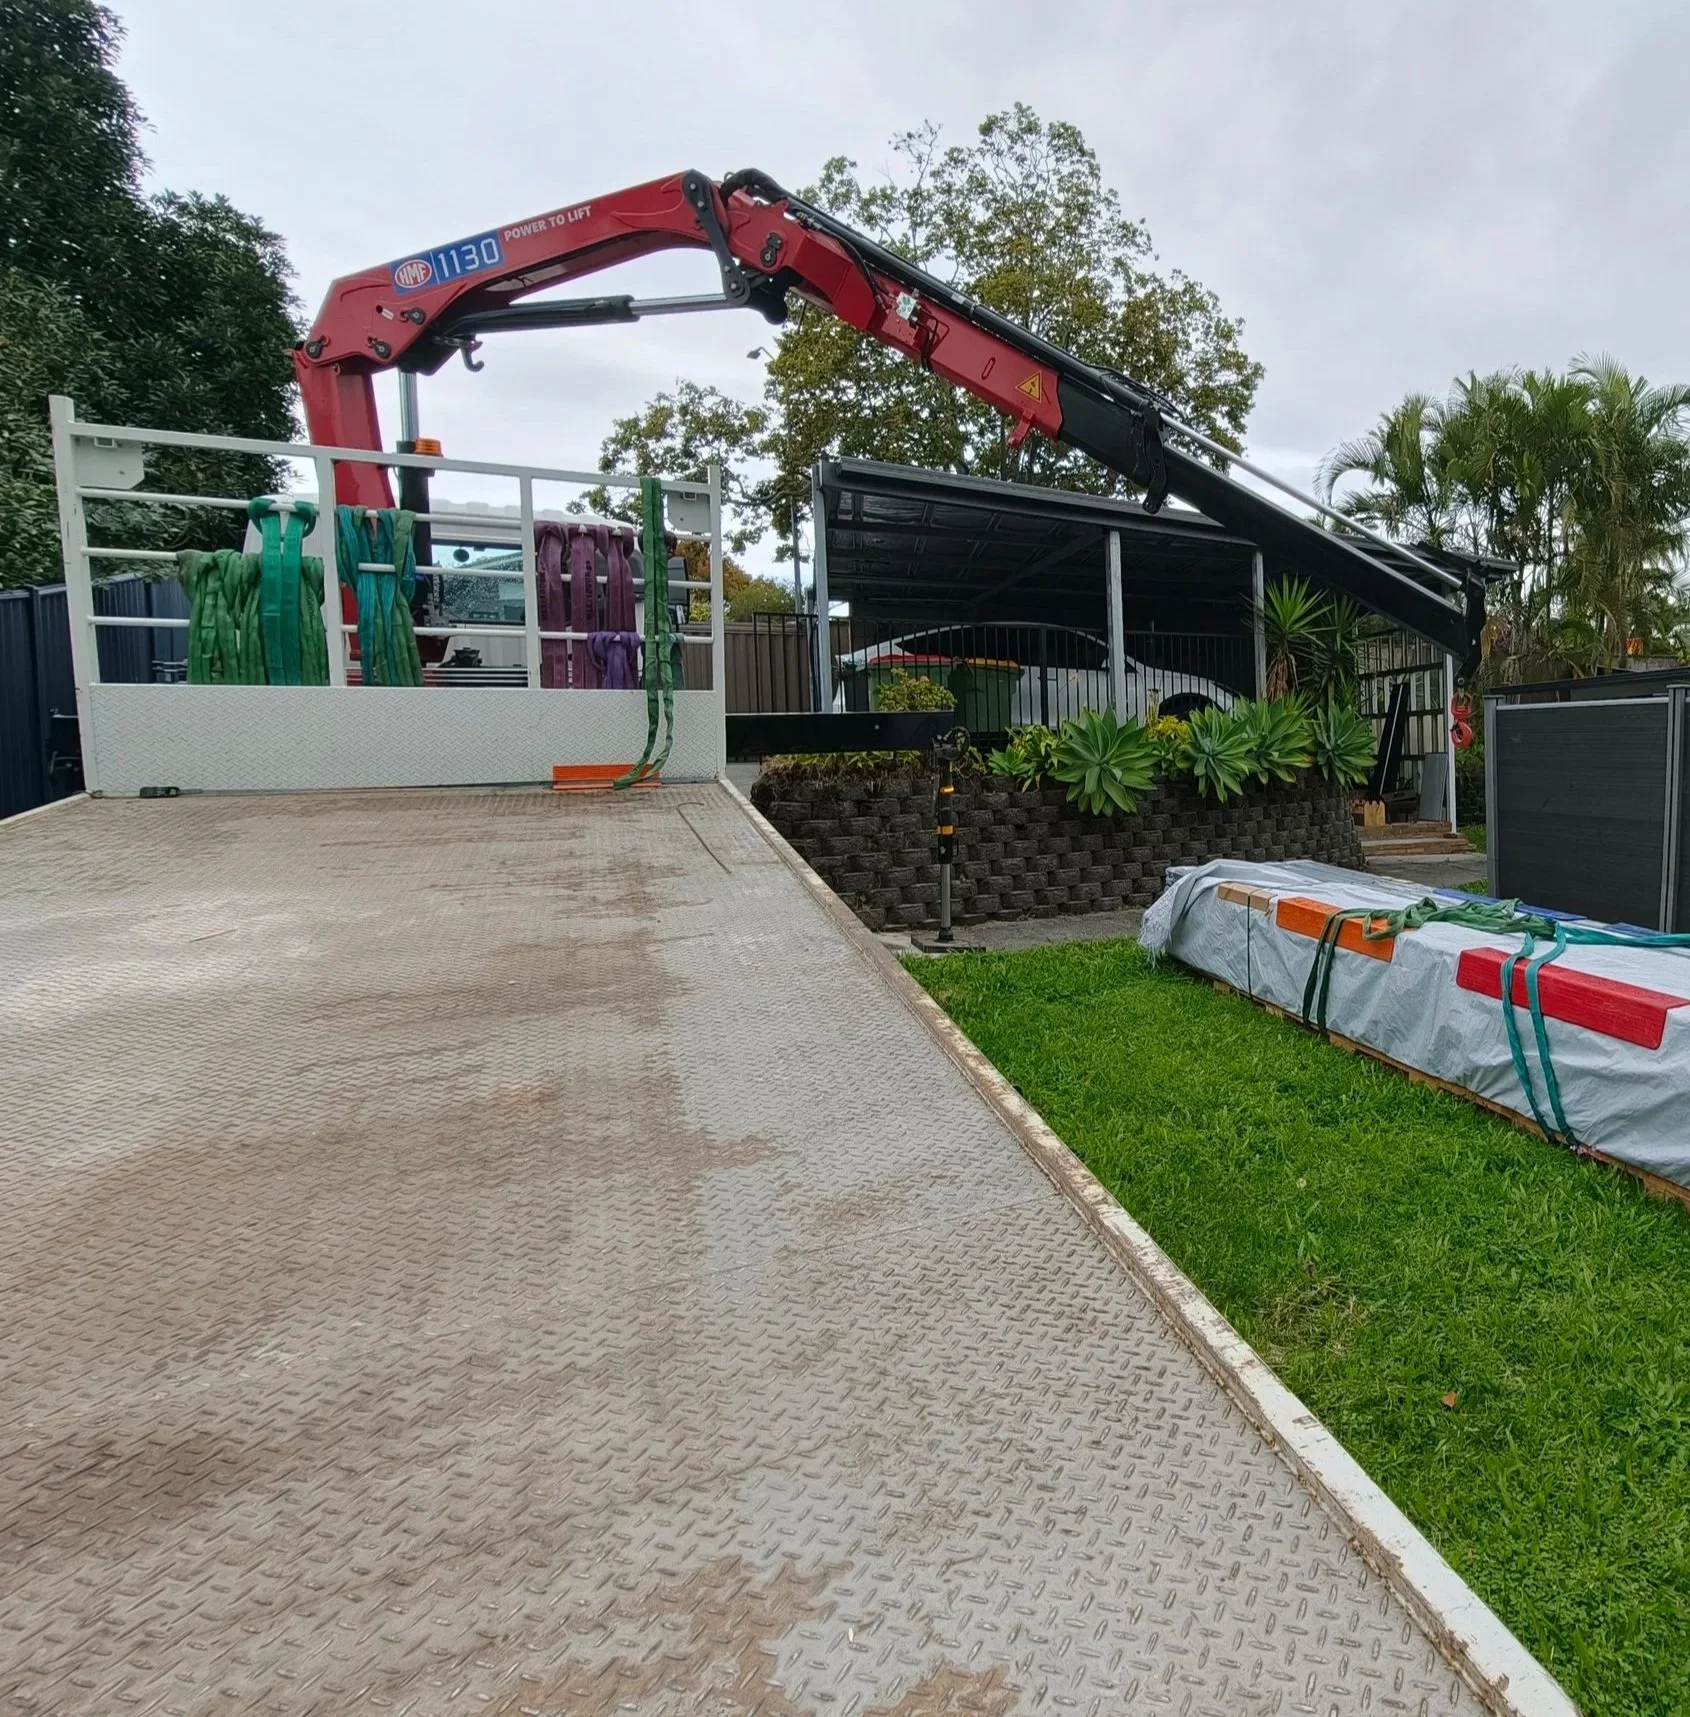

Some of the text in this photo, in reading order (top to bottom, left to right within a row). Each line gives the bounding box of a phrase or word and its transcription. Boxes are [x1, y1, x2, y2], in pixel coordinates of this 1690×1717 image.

[504, 206, 592, 242] POWER TO LIFT
[400, 238, 500, 286] HMF 1130
